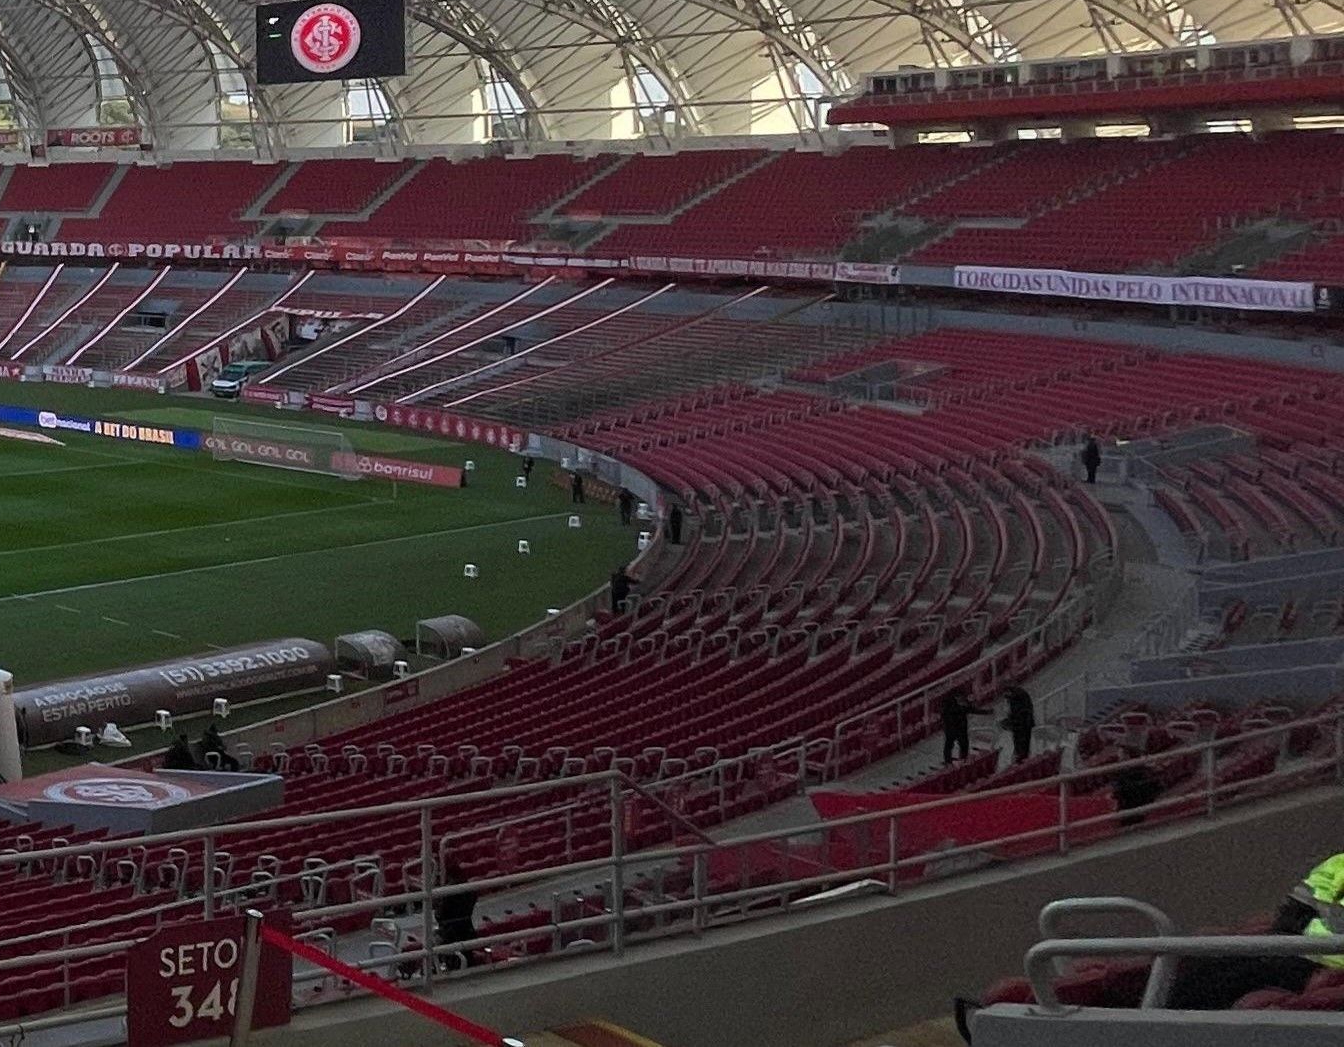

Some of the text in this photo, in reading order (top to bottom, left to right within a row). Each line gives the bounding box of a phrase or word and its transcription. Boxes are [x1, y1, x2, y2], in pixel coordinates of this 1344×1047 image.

[1, 241, 263, 259] GUARDA POPULAR
[957, 270, 1043, 292] TORCIDAS
[1046, 277, 1111, 297] UNIDAS
[1115, 280, 1161, 300] PELO
[1171, 282, 1308, 307] INTERNACIONAL
[373, 460, 433, 480] banrisul
[159, 935, 244, 978] SETO
